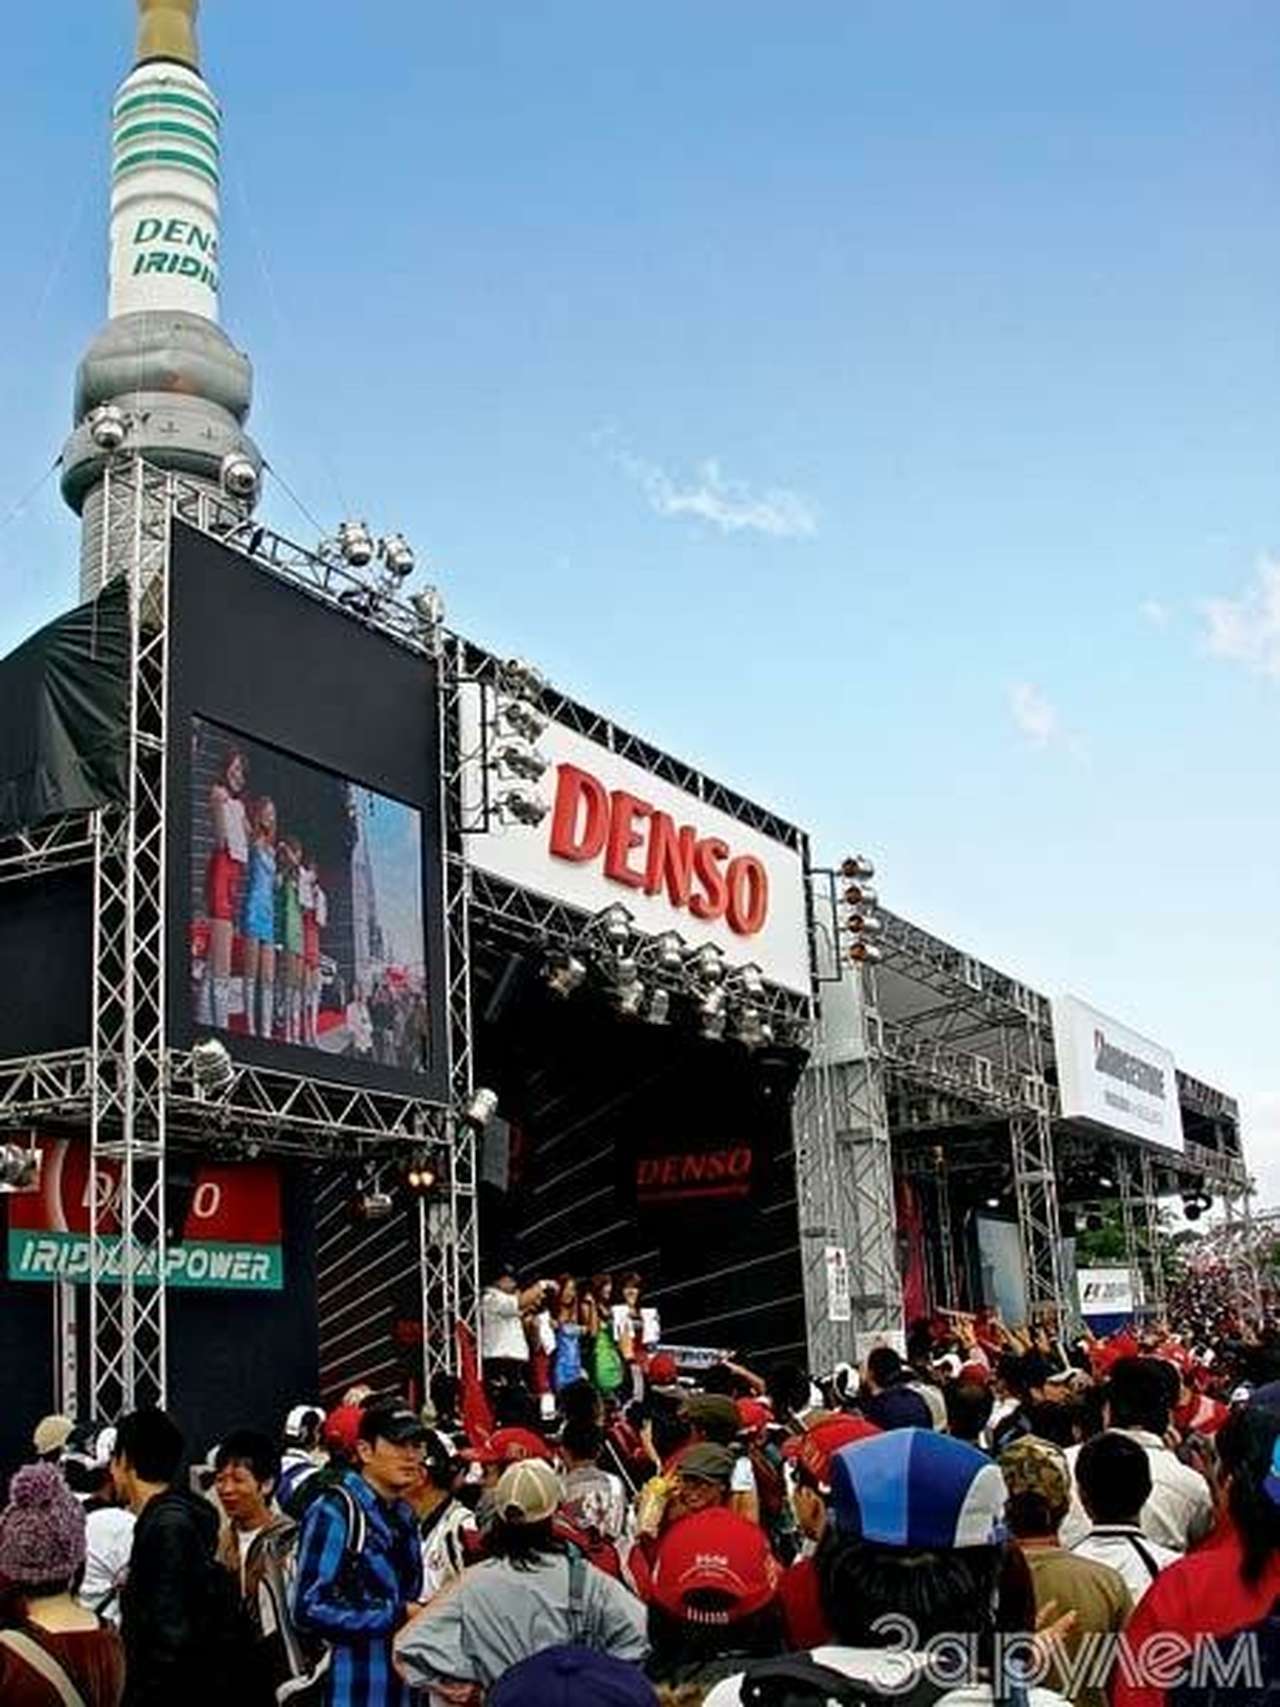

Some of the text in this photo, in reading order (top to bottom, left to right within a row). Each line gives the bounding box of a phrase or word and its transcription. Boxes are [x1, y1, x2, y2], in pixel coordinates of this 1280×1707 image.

[549, 763, 768, 935] DENSO
[637, 1148, 752, 1184] DENSO
[165, 1248, 271, 1281] POWER
